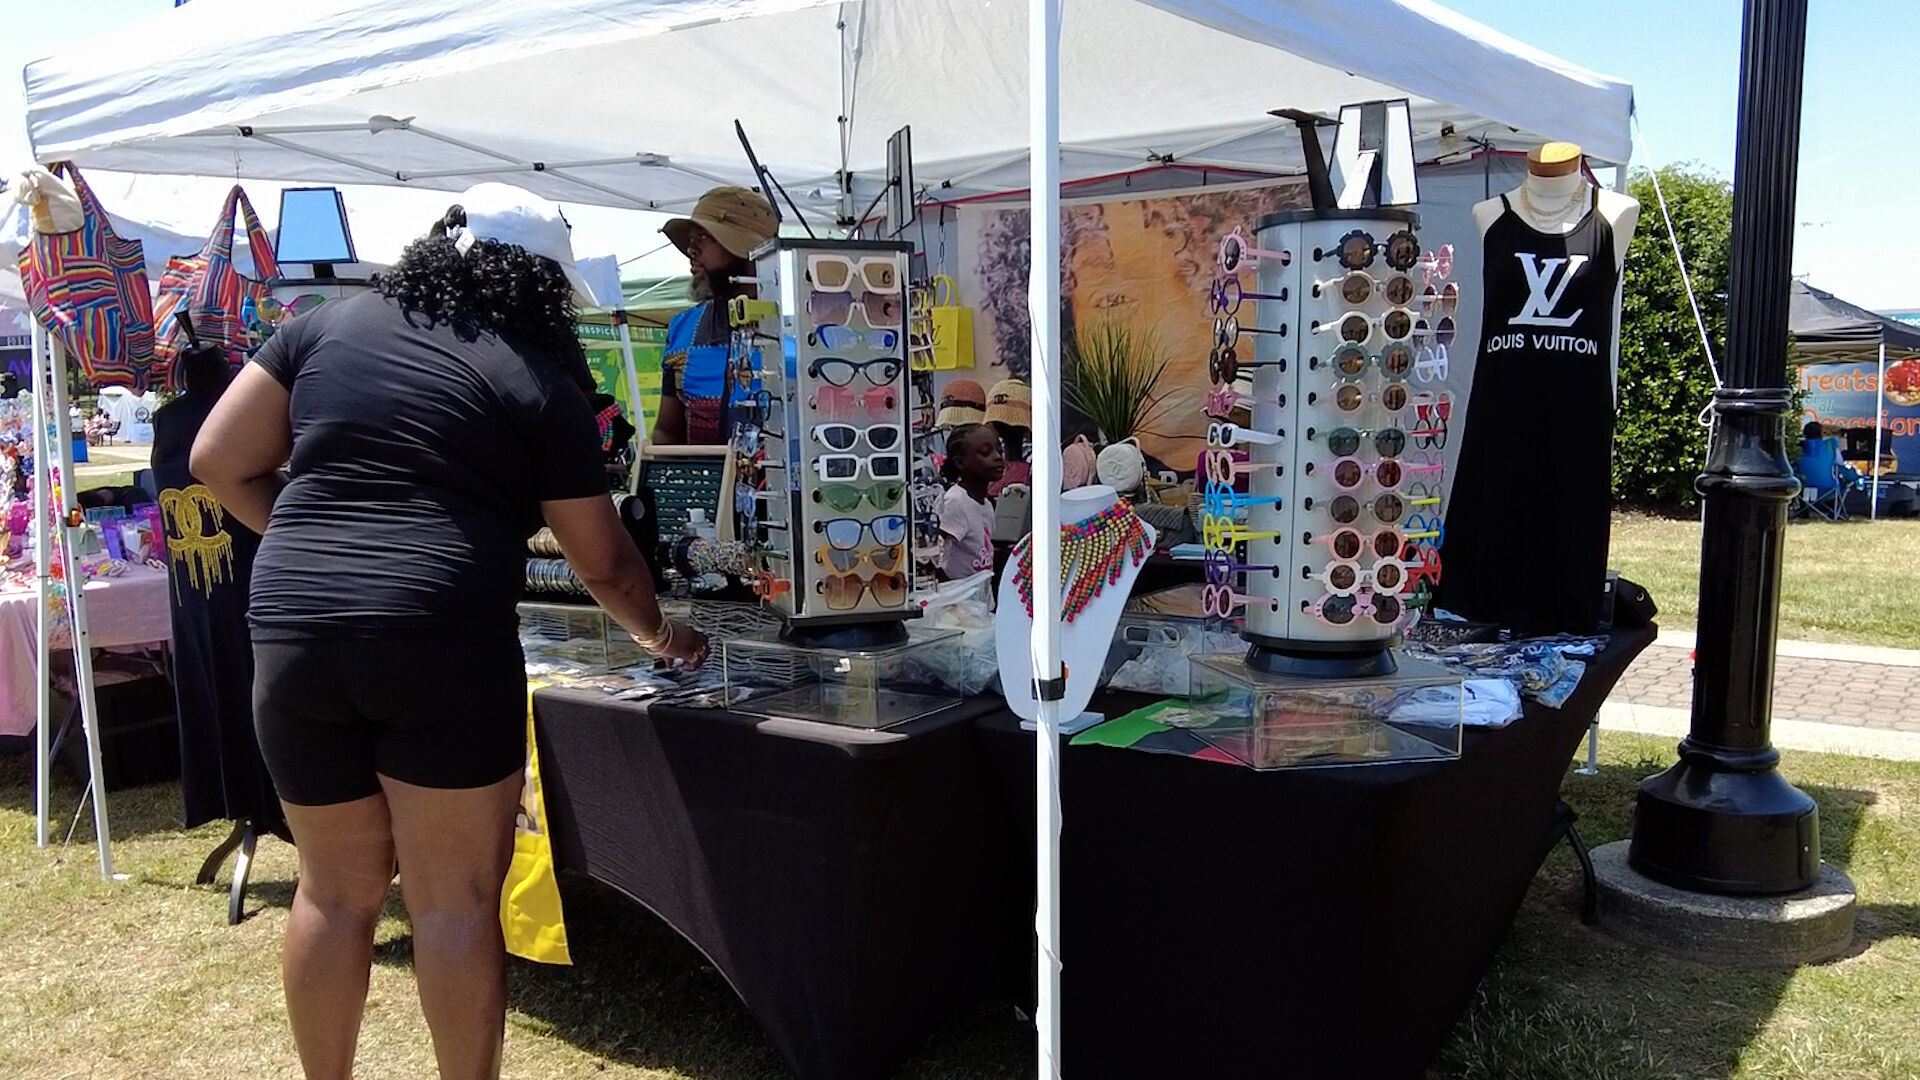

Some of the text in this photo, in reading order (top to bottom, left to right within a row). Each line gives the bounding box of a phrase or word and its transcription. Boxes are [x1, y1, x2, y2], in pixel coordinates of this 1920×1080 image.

[1487, 332, 1598, 356] LOUIS VUITTON
[1797, 364, 1879, 393] Treats
